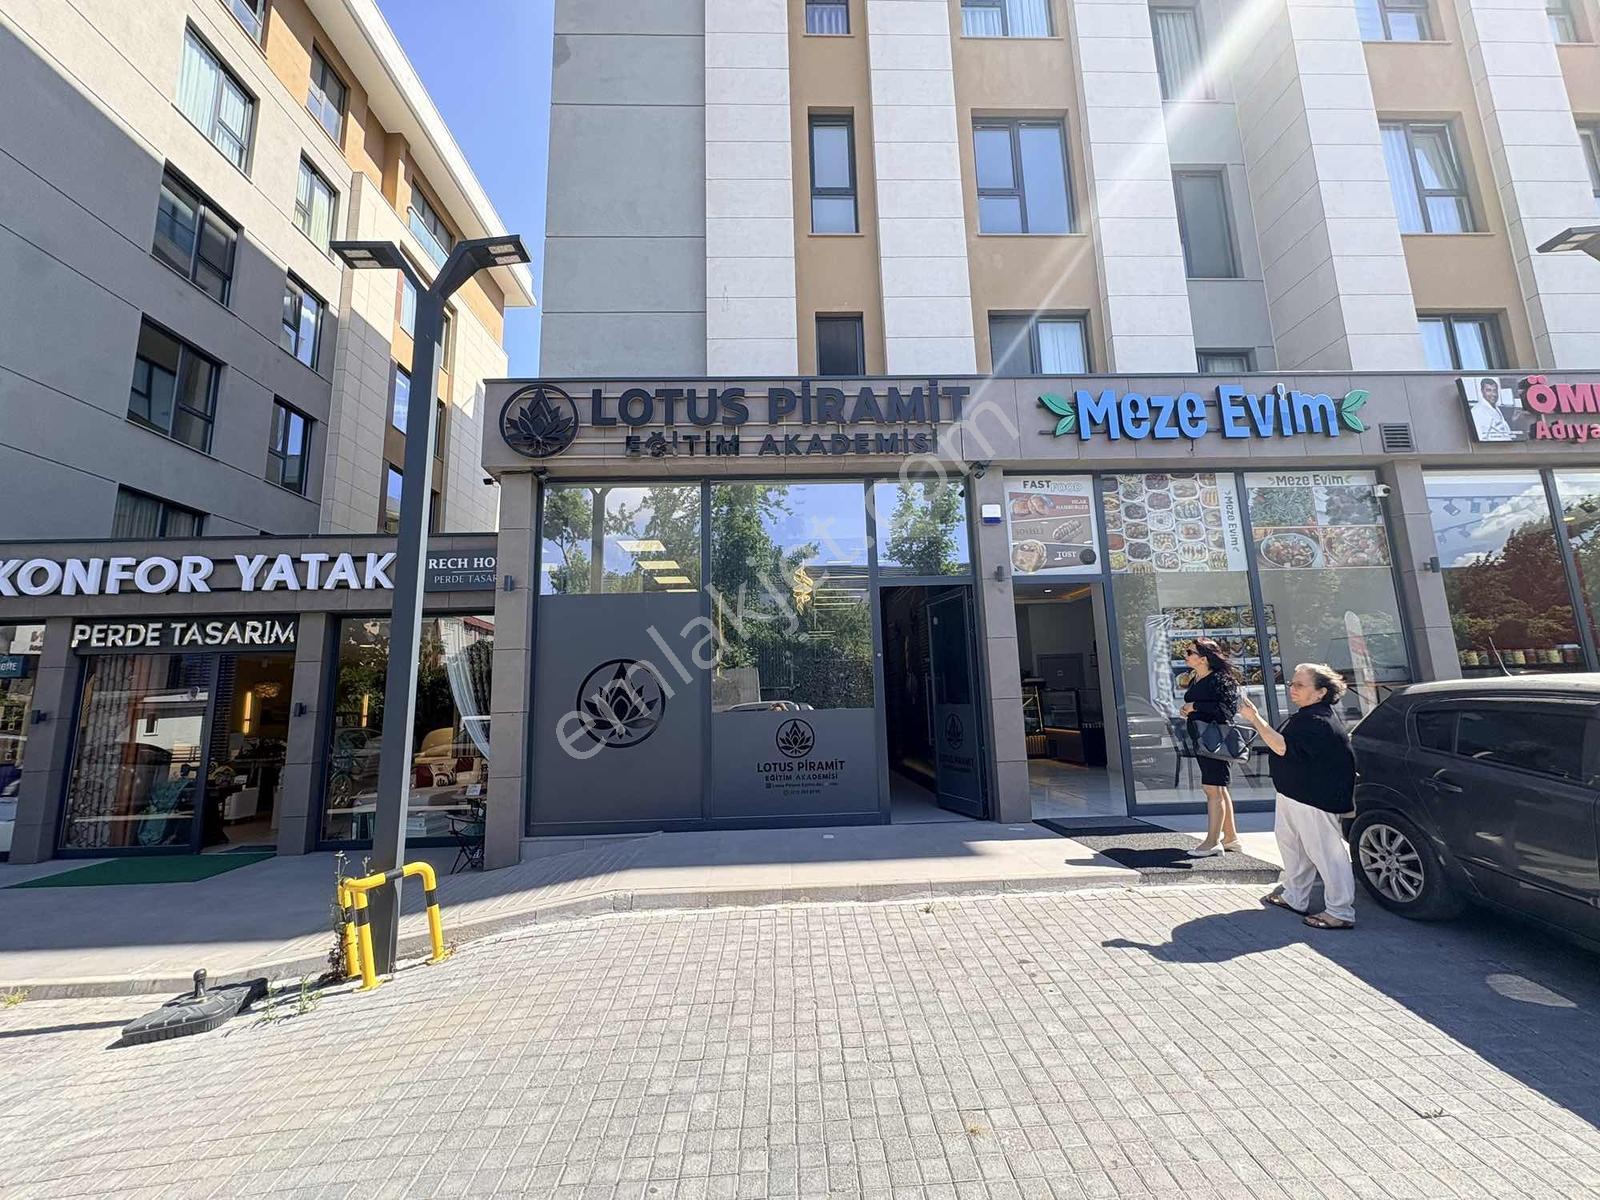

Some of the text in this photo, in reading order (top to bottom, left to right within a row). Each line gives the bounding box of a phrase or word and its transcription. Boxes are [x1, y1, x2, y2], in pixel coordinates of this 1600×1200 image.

[592, 379, 970, 427] LOTUS PİRAMİT
[1074, 382, 1340, 441] Meze Evim
[625, 428, 938, 457] EĞİTİM AKADEMİSİ
[1023, 480, 1051, 489] FAST
[1276, 474, 1344, 487] Meze Evim
[1224, 496, 1239, 547] Meze Evim
[0, 552, 398, 597] KONFOR YATAK
[428, 558, 468, 569] RECH
[434, 575, 465, 584] PERDE
[70, 619, 296, 649] PERDE TASARIM
[757, 758, 845, 773] LOTUS PİRAMİT
